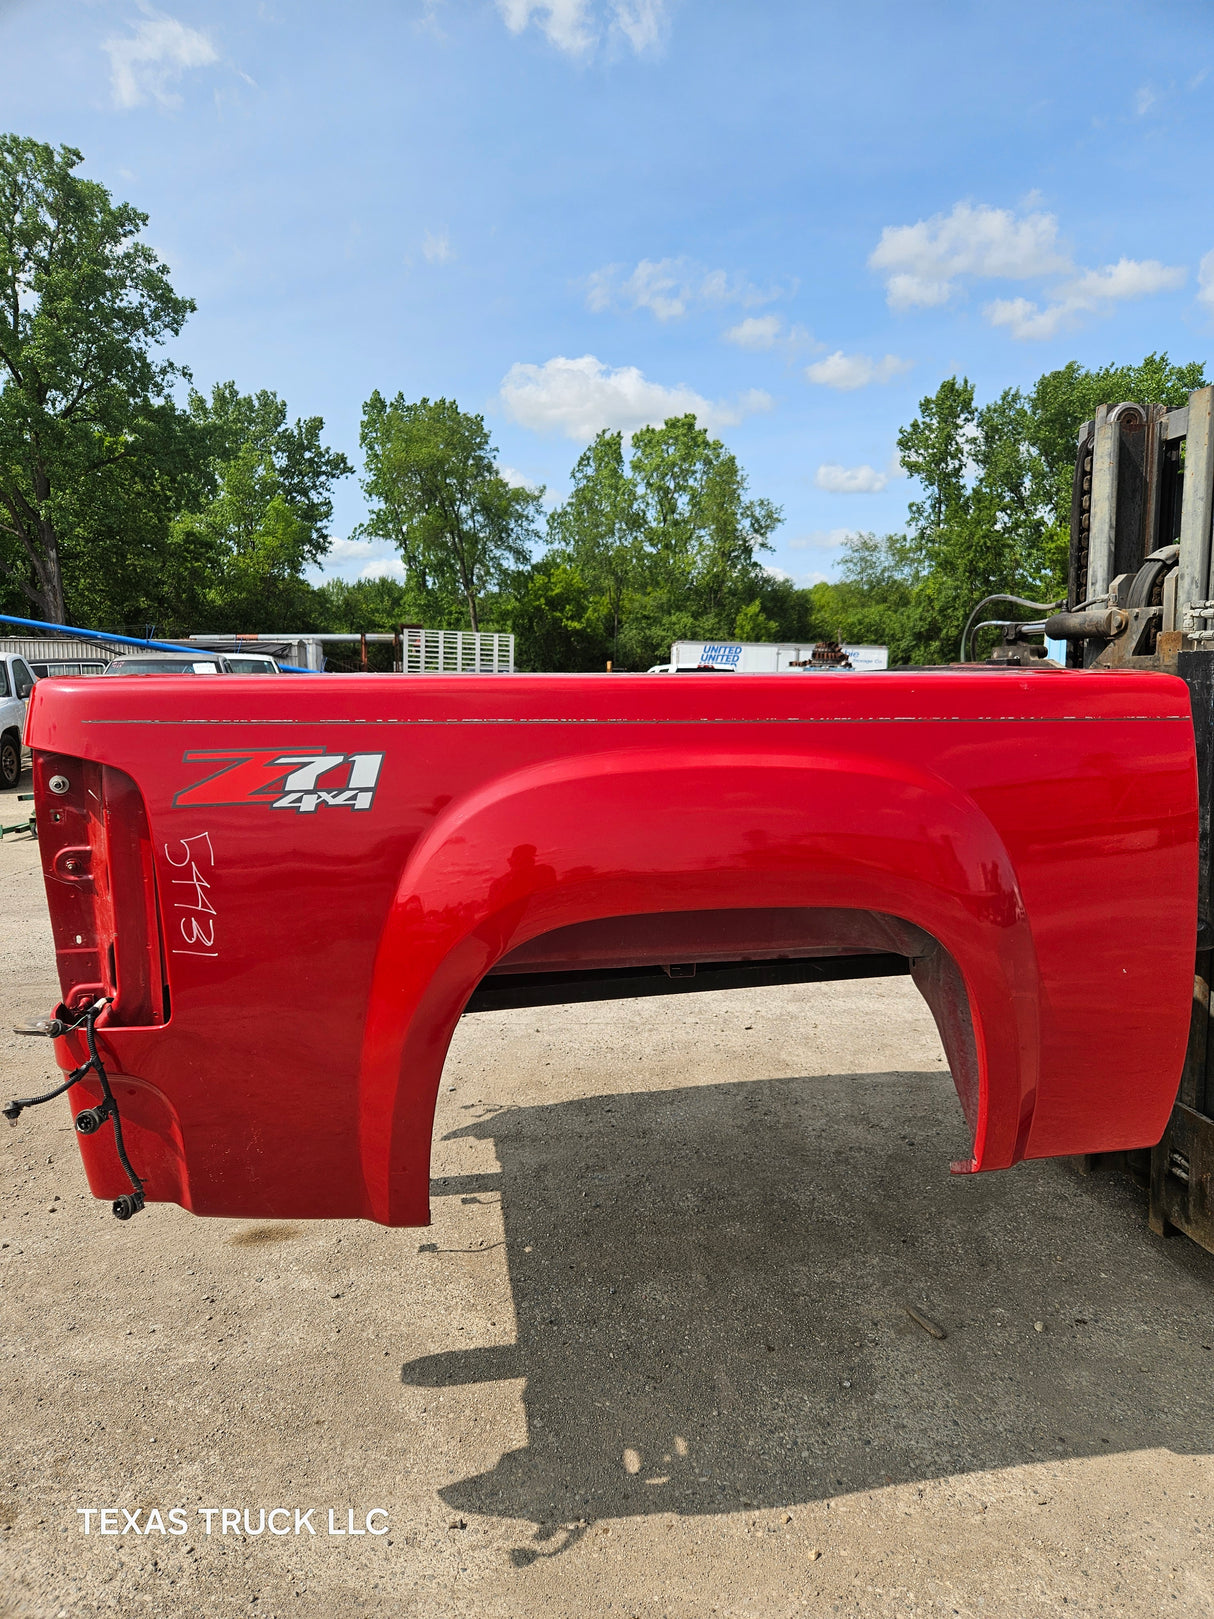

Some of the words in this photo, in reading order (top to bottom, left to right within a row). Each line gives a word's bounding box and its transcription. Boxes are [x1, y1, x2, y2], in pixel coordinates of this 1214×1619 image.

[703, 645, 742, 655] UNITED
[700, 653, 740, 663] UNITED
[172, 746, 386, 808] Z71
